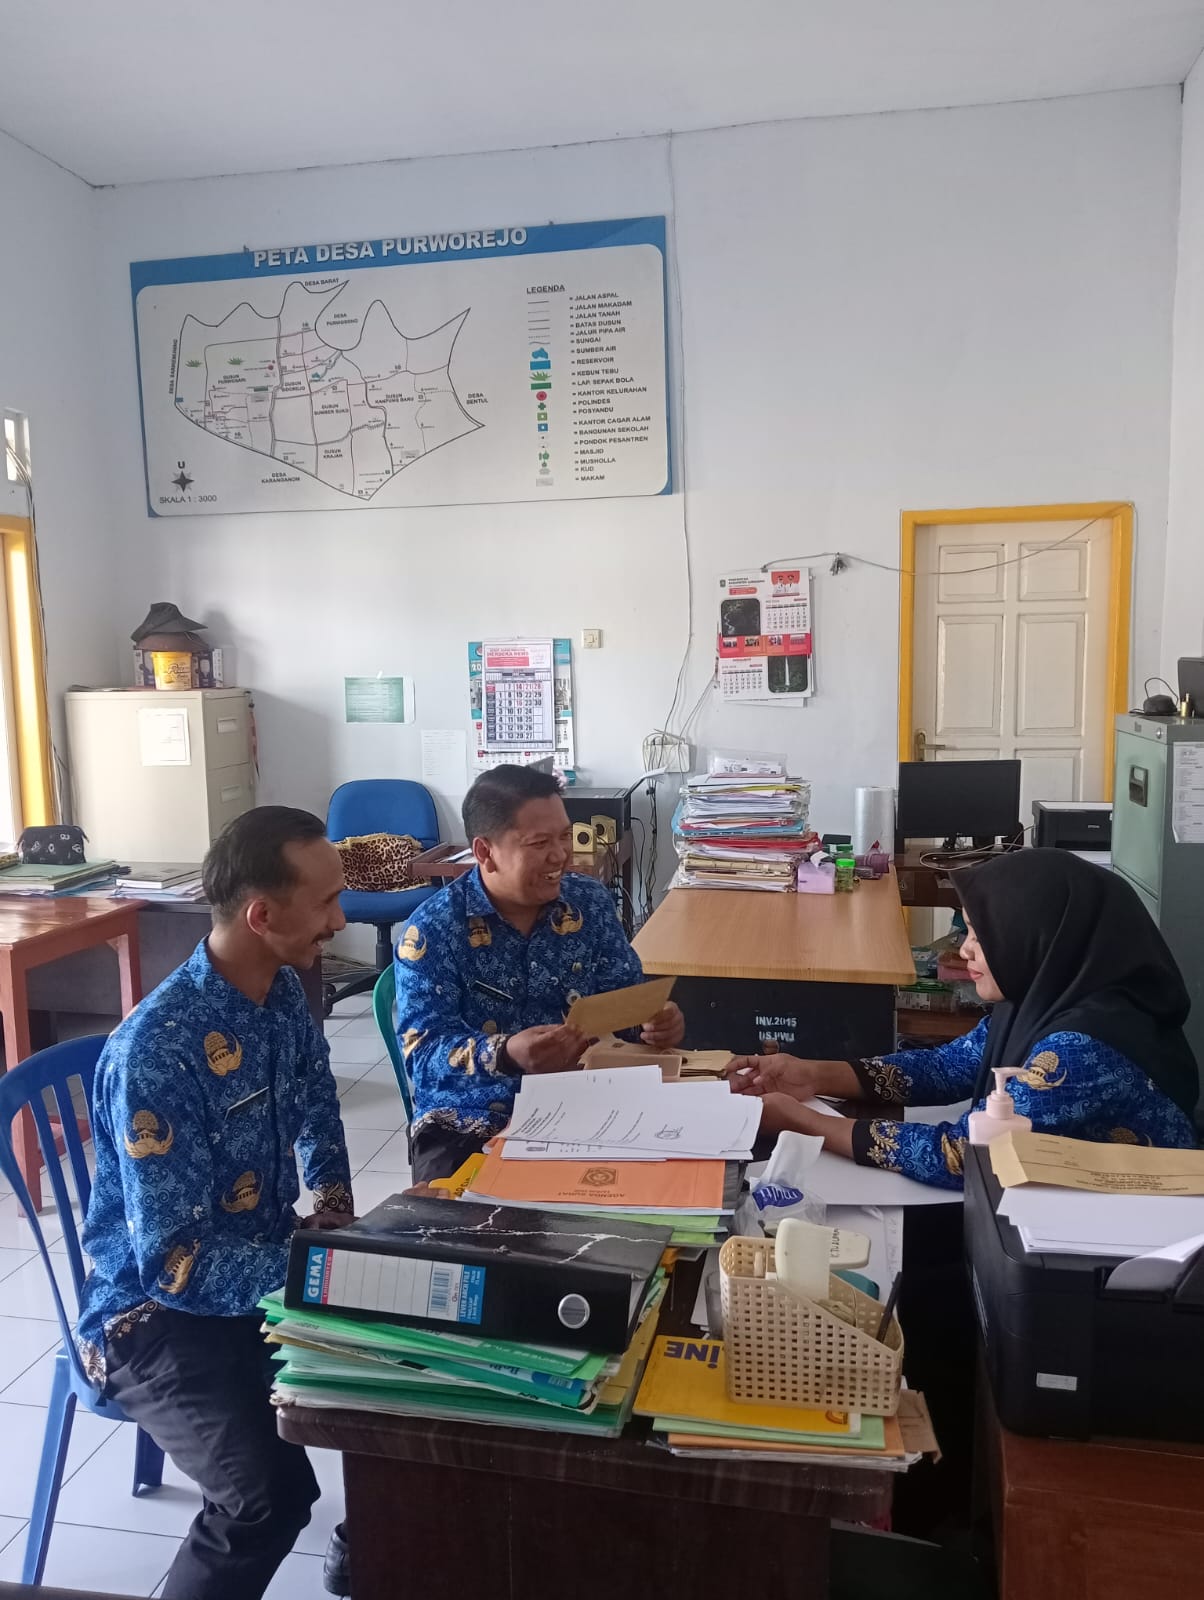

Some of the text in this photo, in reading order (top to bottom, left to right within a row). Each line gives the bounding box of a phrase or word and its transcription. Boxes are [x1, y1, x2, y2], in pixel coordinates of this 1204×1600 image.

[254, 226, 528, 268] PETA DESA PURWOREJO
[526, 284, 565, 294] LEGENDA
[598, 292, 619, 300] ASPAL
[598, 300, 632, 308] MAKADAM
[598, 310, 620, 318] TANAH
[577, 357, 614, 365] RESERVOIR
[578, 387, 647, 397] KANTOR KELURAHAN
[578, 398, 610, 406] POLINDES
[578, 418, 605, 426] KANTOR
[579, 428, 616, 436] BANGUNAN
[178, 461, 185, 469] U
[160, 496, 187, 504] SKALA
[756, 1016, 797, 1027] INV.2015
[308, 1253, 323, 1298] GEMA
